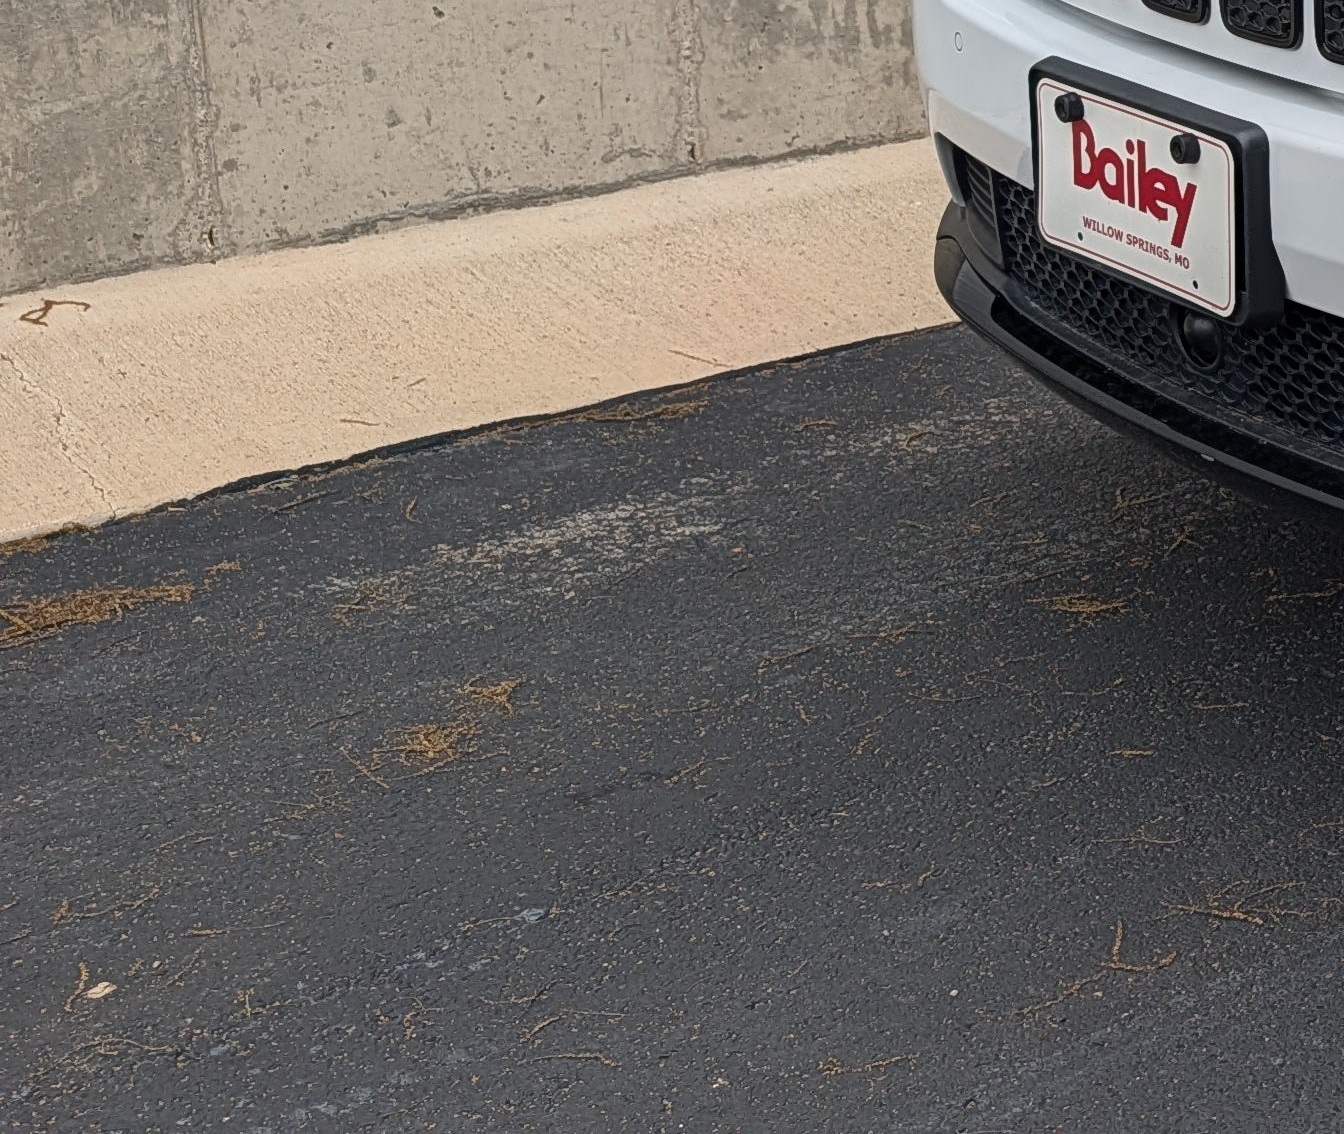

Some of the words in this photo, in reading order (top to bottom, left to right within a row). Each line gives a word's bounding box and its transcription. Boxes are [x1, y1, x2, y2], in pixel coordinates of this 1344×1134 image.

[1071, 118, 1198, 249] Bailey
[1082, 215, 1124, 243] WILLOW
[1125, 233, 1172, 264] SPRINGS,
[1174, 252, 1190, 270] MO
